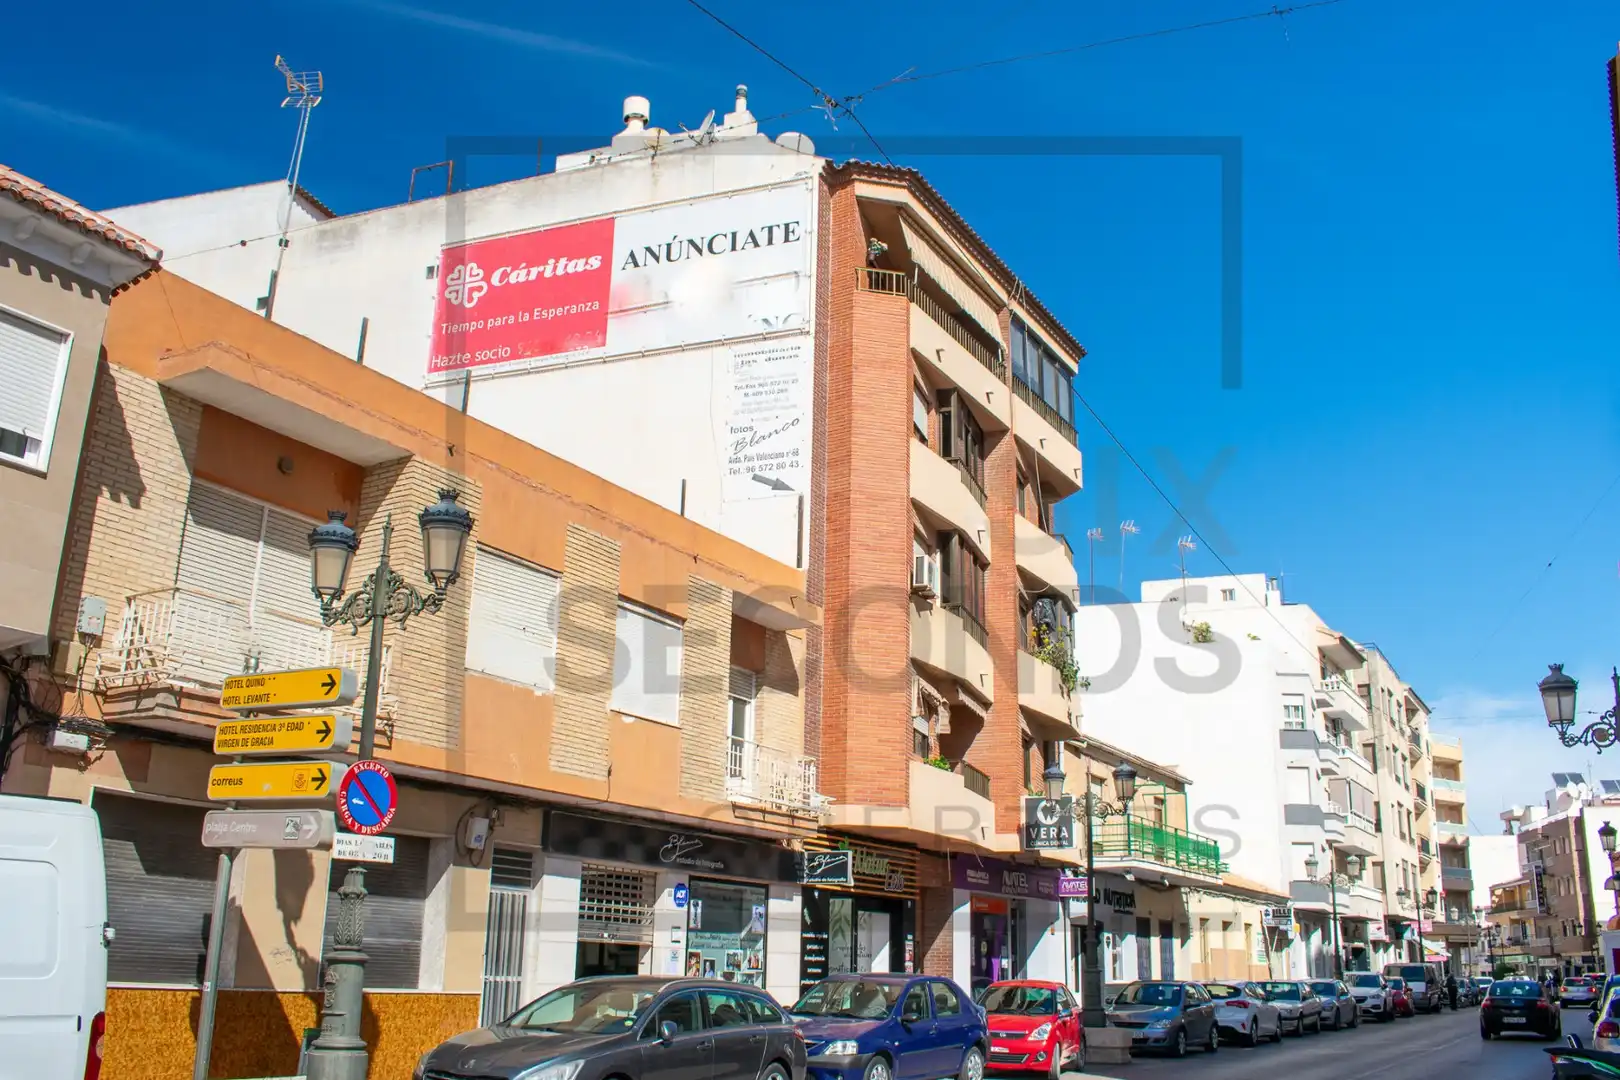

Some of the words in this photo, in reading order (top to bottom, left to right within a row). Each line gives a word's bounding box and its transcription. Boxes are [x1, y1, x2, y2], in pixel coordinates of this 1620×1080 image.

[621, 220, 801, 272] ANÚNCIATE
[490, 254, 603, 288] Cáritas
[440, 321, 485, 335] Tiempo
[487, 315, 516, 330] para
[518, 311, 529, 323] la
[533, 300, 600, 321] Esperanza
[431, 351, 471, 369] Hazte
[475, 345, 511, 362] socio
[730, 425, 754, 435] fotos
[730, 417, 800, 456] Blanco
[758, 462, 774, 472] 572
[776, 461, 787, 470] 80
[788, 459, 800, 469] 43
[224, 679, 244, 690] HOTEL
[245, 677, 266, 688] QUINO
[222, 695, 241, 706] HOTEL
[243, 693, 271, 704] LEVANTE
[219, 725, 238, 736] HOTEL
[239, 723, 277, 735] RESIDENCIA
[286, 721, 305, 732] EDAD
[217, 738, 240, 749] VIRGEN
[240, 737, 249, 748] DE
[250, 736, 274, 747] GRACIA
[353, 762, 389, 778] EXCEPTO
[211, 777, 243, 786] correus
[340, 790, 353, 825] CARGA
[354, 823, 361, 831] Y
[361, 807, 397, 835] DESCARGA
[1029, 826, 1069, 839] VERA
[676, 889, 686, 898] ADT
